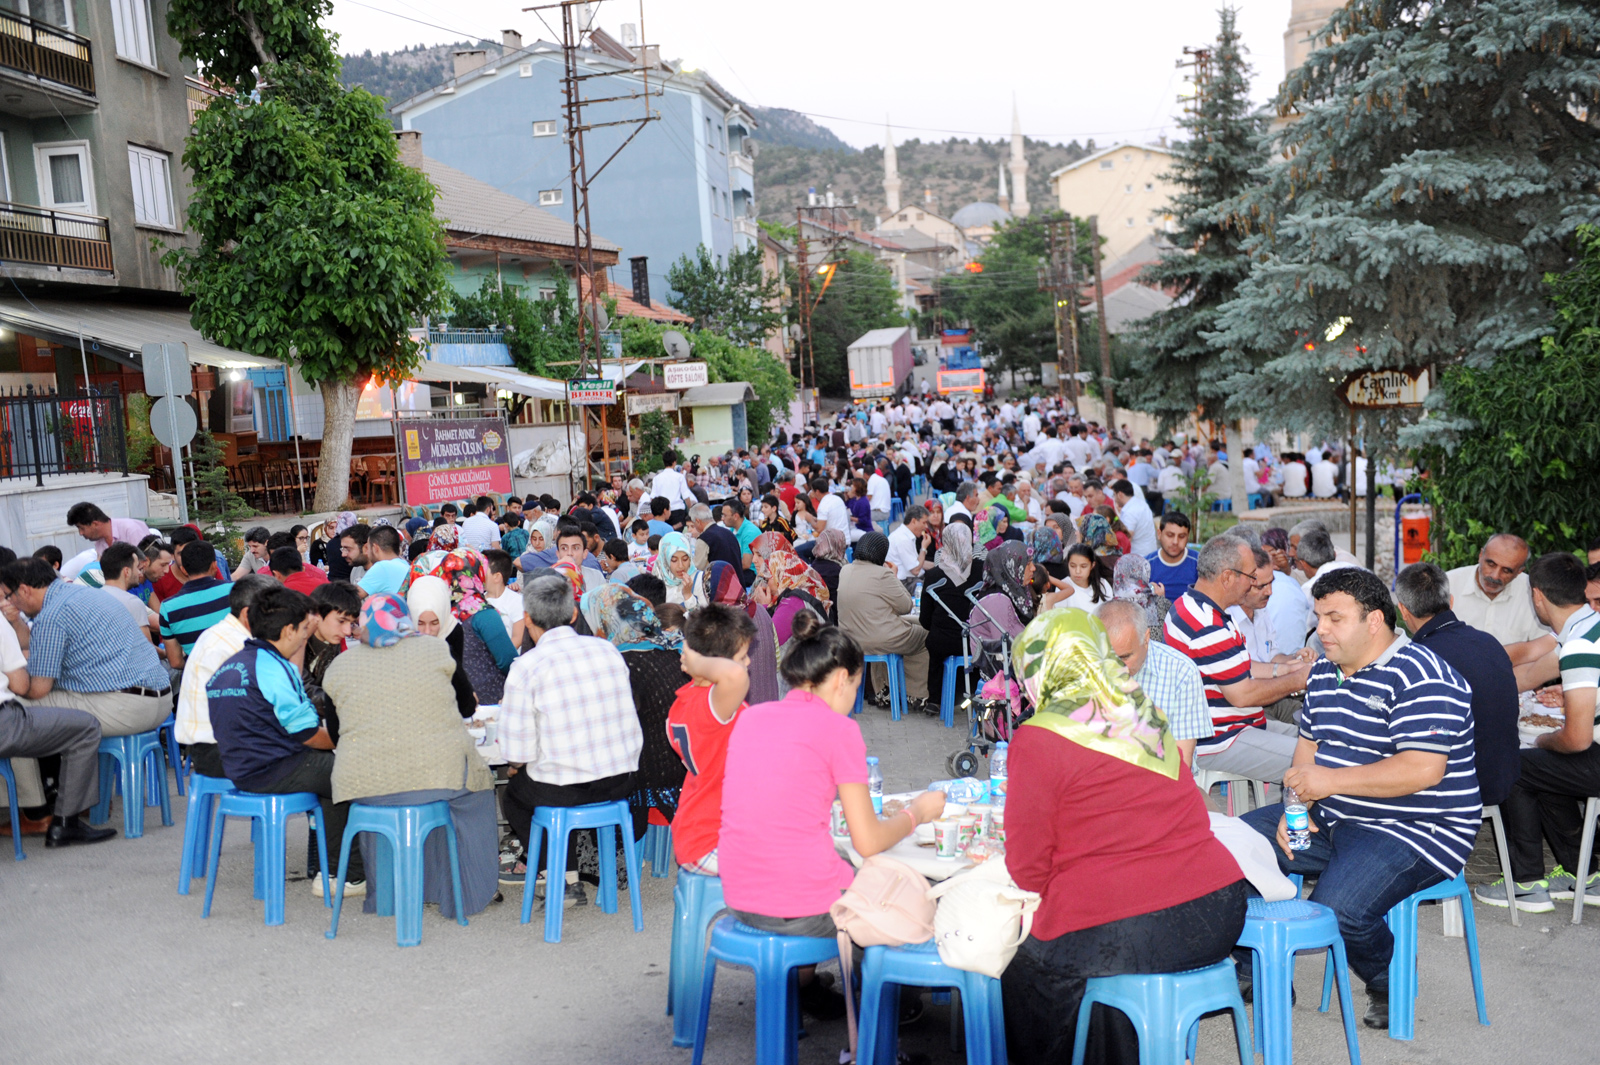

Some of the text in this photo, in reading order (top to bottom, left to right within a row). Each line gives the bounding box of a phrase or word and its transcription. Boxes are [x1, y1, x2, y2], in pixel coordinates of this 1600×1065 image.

[1362, 373, 1407, 392] Çamlık
[571, 391, 613, 399] BERBER
[434, 429, 458, 441] RAHMET
[431, 442, 462, 458] MÜBAREK
[462, 440, 483, 456] OLSUN
[429, 473, 450, 487] GÖNÜL
[428, 485, 453, 501] İFTARDA
